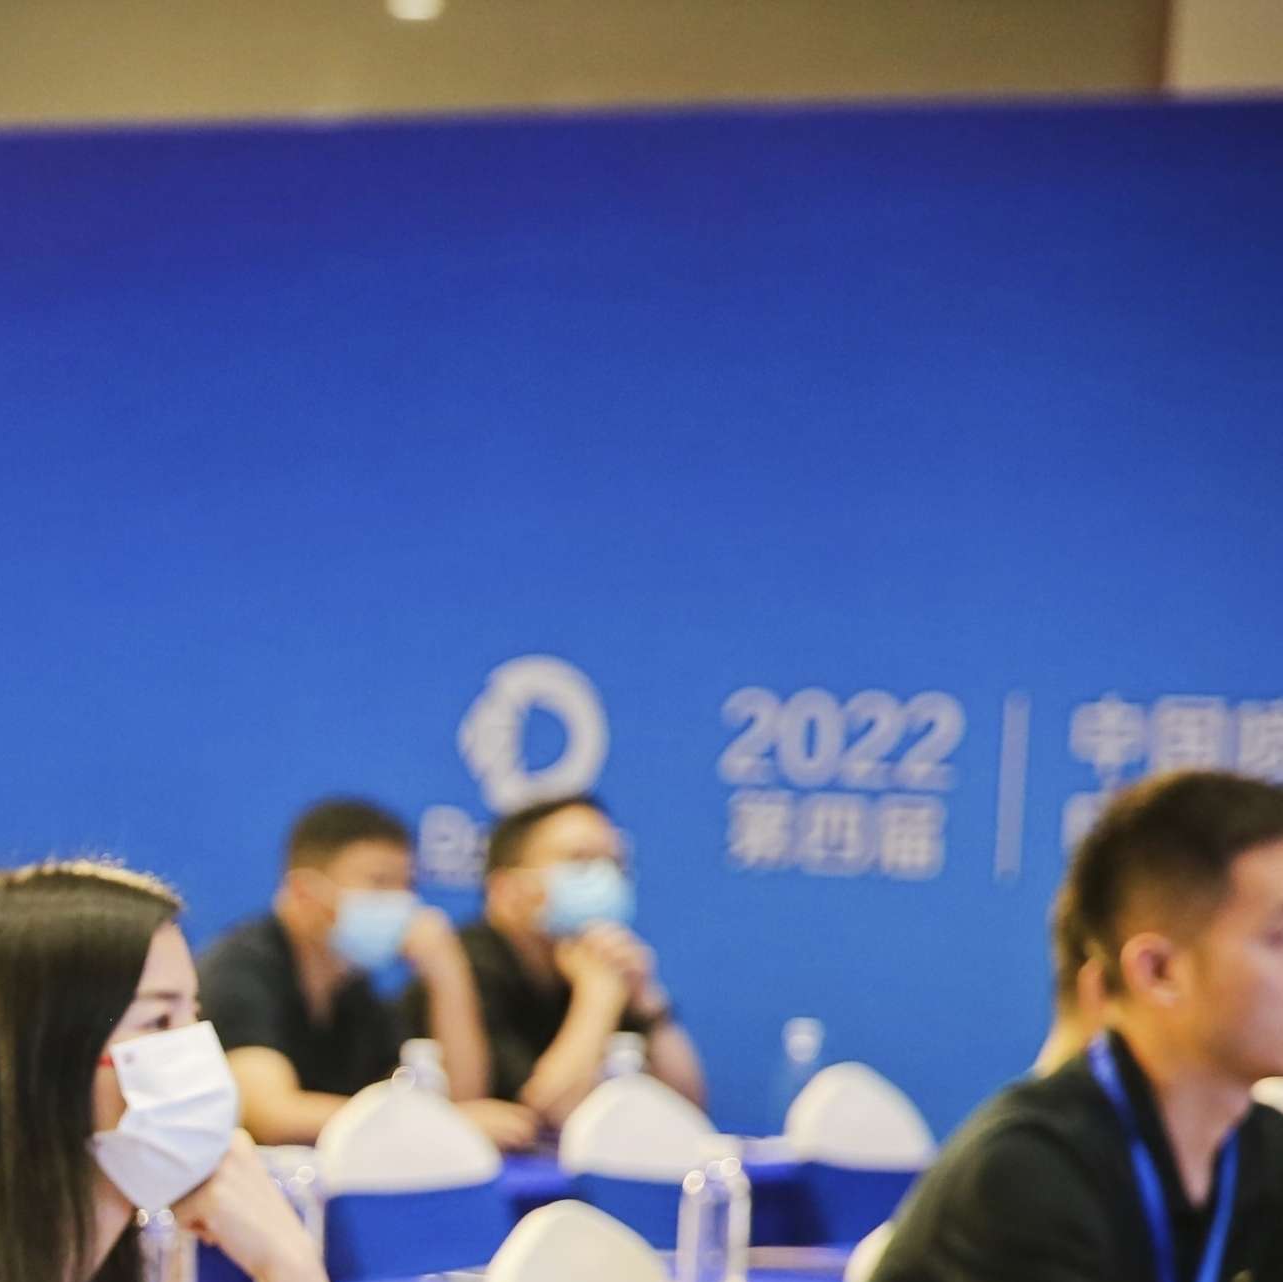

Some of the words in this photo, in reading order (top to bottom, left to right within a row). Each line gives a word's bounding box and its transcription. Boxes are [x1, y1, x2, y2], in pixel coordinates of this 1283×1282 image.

[719, 689, 964, 789] 2022
[729, 790, 945, 878] 第四届
